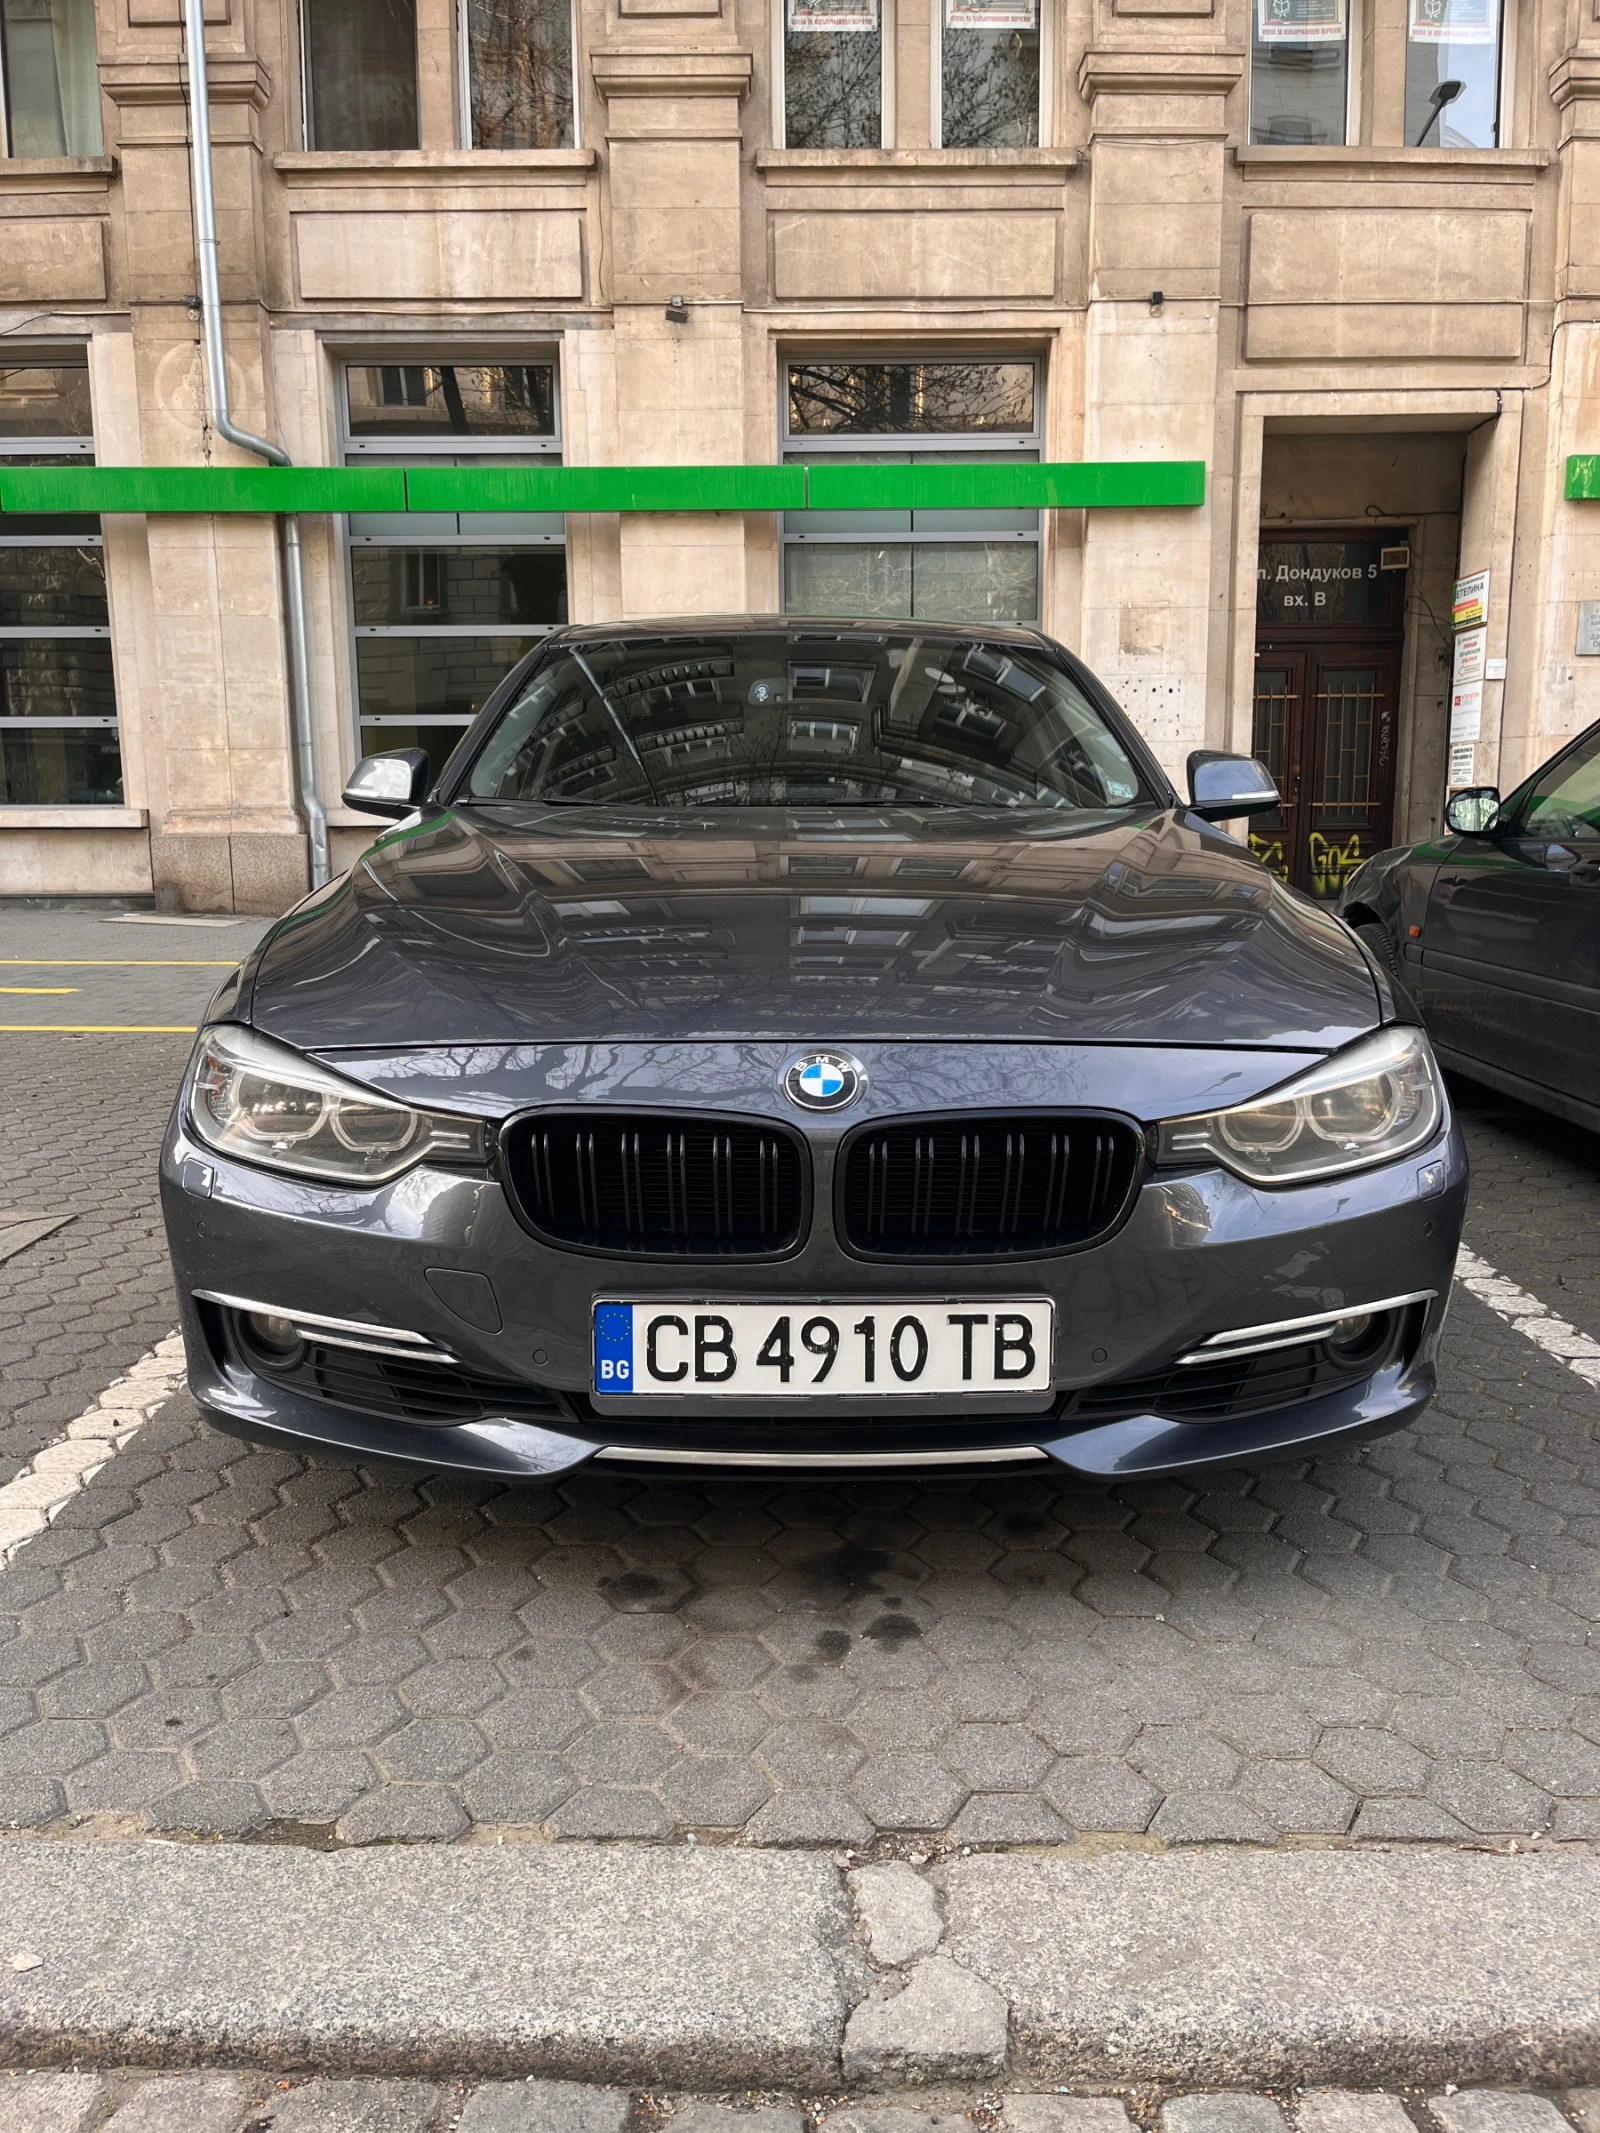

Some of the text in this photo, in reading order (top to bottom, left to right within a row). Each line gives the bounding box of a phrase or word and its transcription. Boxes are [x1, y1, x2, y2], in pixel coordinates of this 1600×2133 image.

[1276, 564, 1362, 583] Дондуков
[1367, 564, 1377, 579] 5
[1283, 592, 1326, 607] вх. В
[795, 1056, 852, 1073] BMW
[646, 1314, 1036, 1383] CB 4910 TB
[601, 1359, 630, 1379] BG
